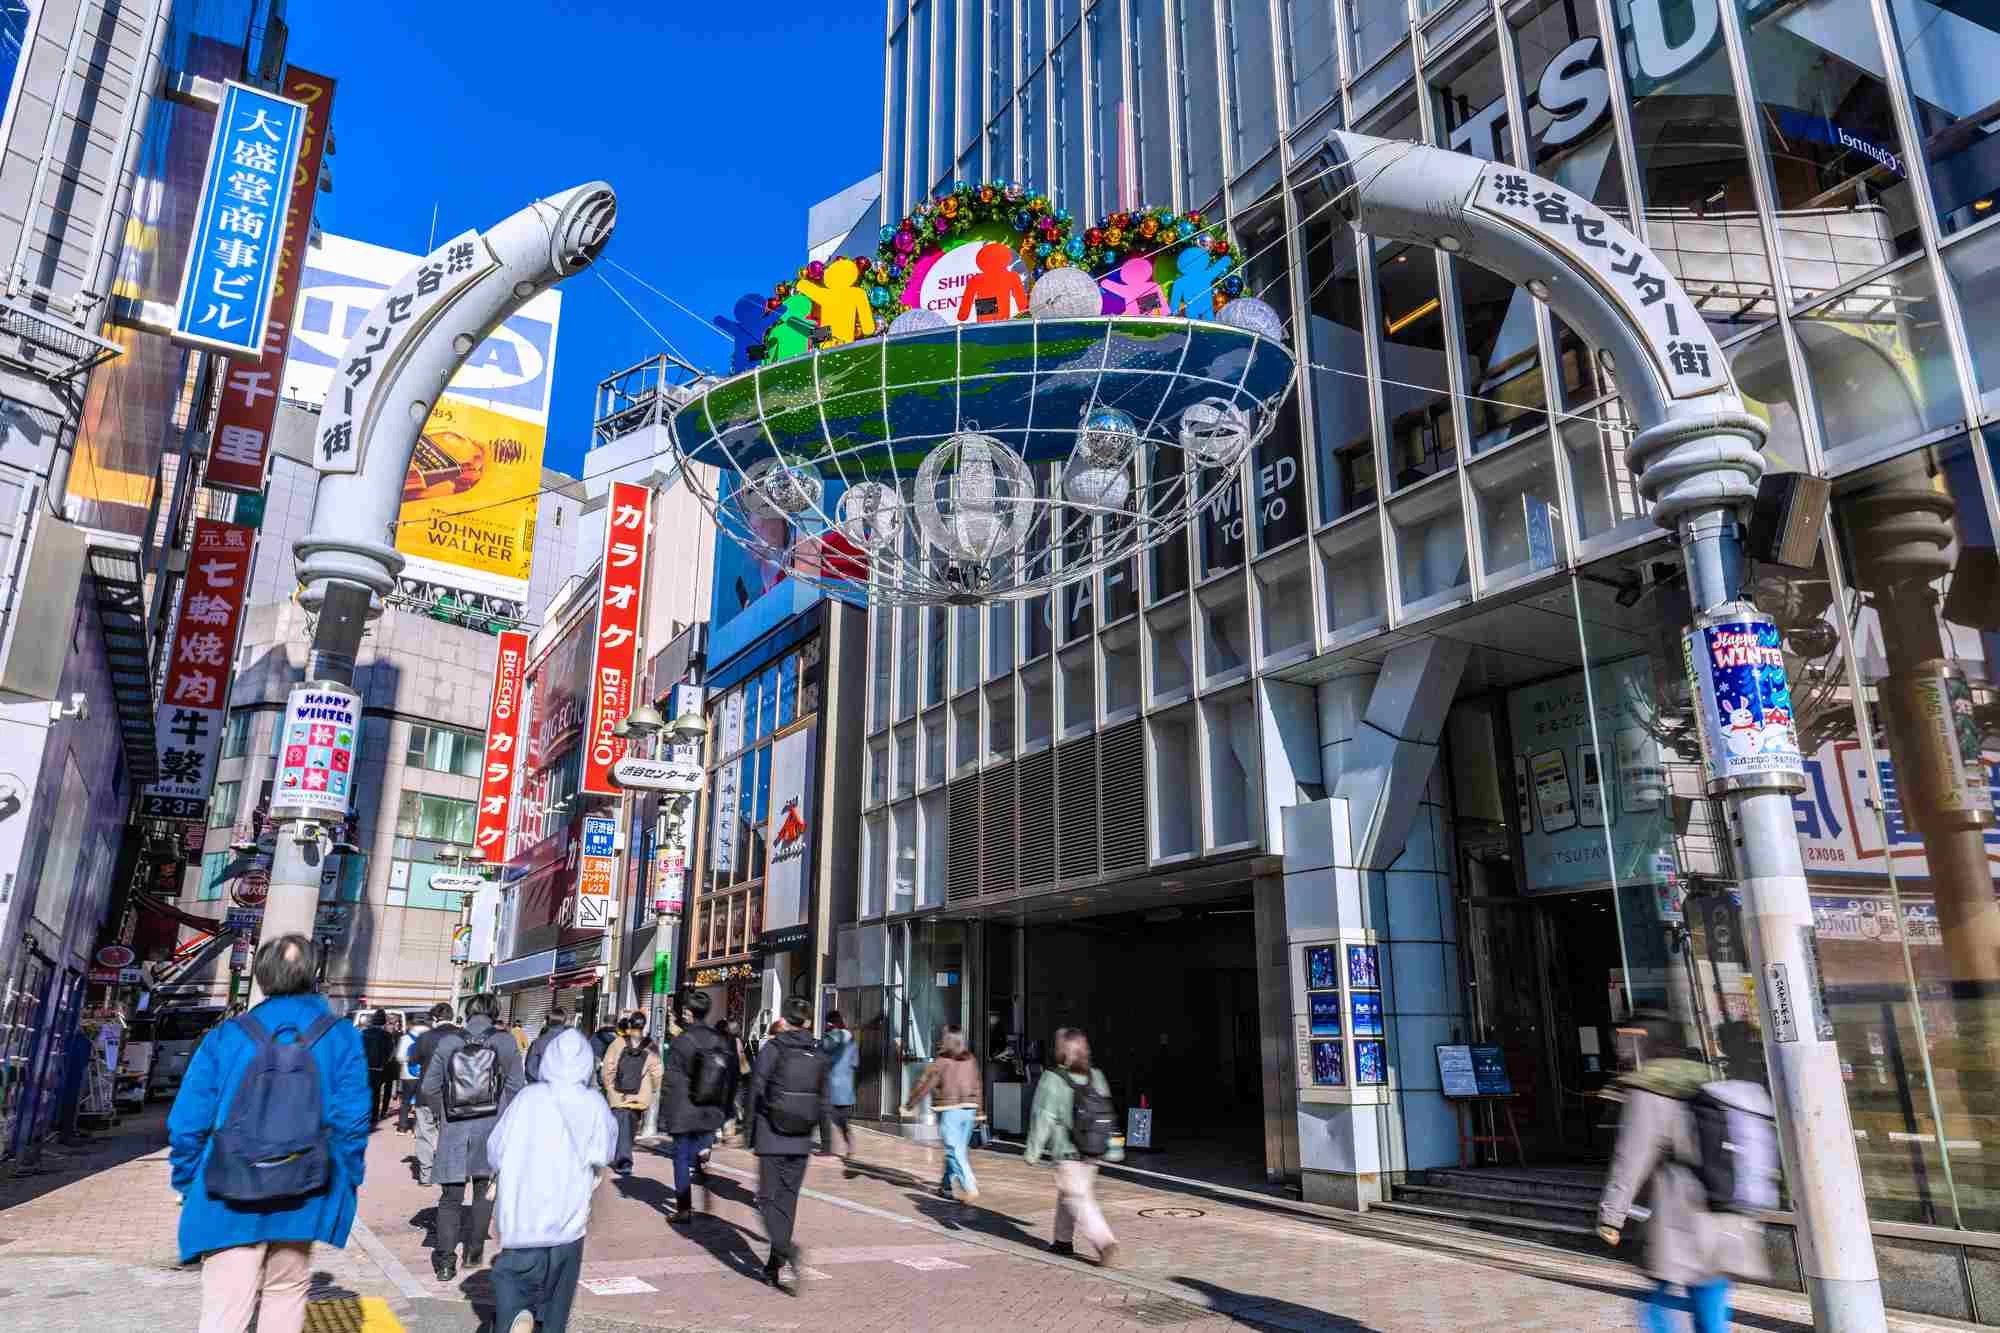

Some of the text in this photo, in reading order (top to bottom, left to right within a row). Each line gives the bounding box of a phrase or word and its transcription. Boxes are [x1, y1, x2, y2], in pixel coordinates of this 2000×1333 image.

[199, 108, 283, 331] 大盛堂商事ビル
[1494, 172, 1712, 378] 渋谷センター街
[322, 241, 475, 463] 渋谷センター街
[1210, 456, 1297, 523] WIED
[1221, 497, 1287, 546] TOYO
[427, 531, 513, 562] WALKER
[428, 517, 515, 549] JOHNNIE
[599, 504, 643, 650] カラオケ
[173, 557, 239, 704] 七輪焼肉
[1712, 648, 1785, 669] WINTE
[297, 708, 353, 724] WINTER
[305, 694, 351, 708] HAPPY
[495, 650, 518, 719] BIG ECHO
[593, 667, 621, 766] BIG ECHO
[160, 708, 209, 784] 牛繁
[620, 766, 702, 782] 渋谷センター街
[478, 732, 513, 847] カラオケ
